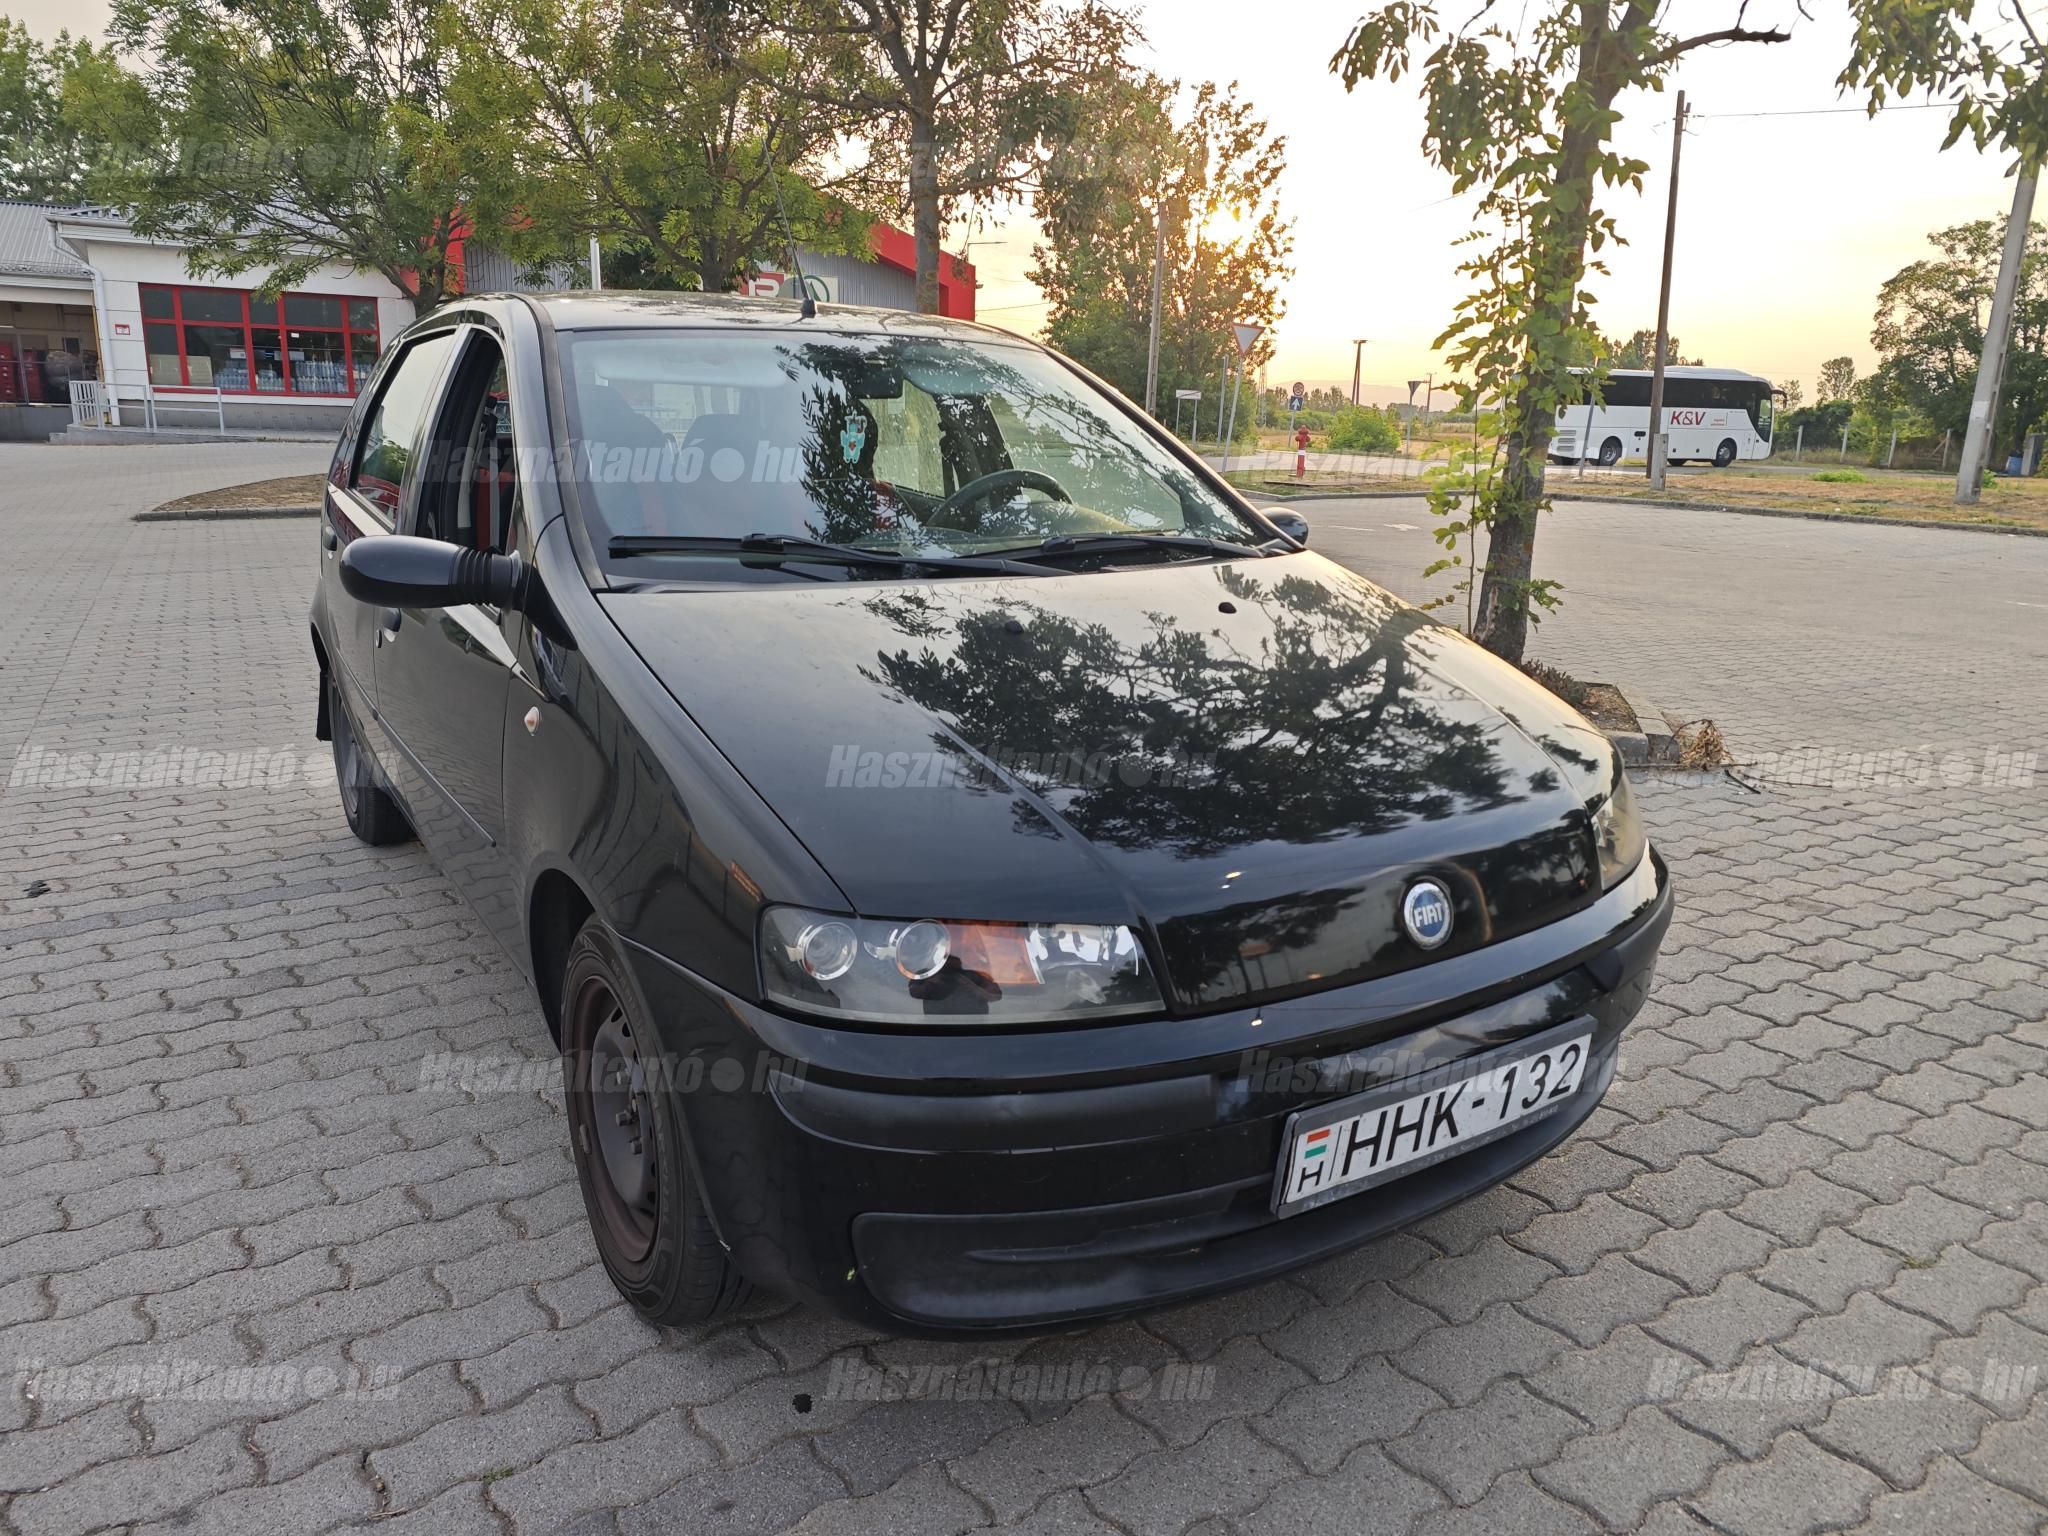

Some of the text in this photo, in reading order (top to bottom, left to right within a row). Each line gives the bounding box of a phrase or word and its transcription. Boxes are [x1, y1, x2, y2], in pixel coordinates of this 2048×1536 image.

[1670, 410, 1706, 426] K&V
[1413, 902, 1442, 928] FIAT
[1340, 1043, 1582, 1178] HHK-132
[1297, 1161, 1324, 1193] H
